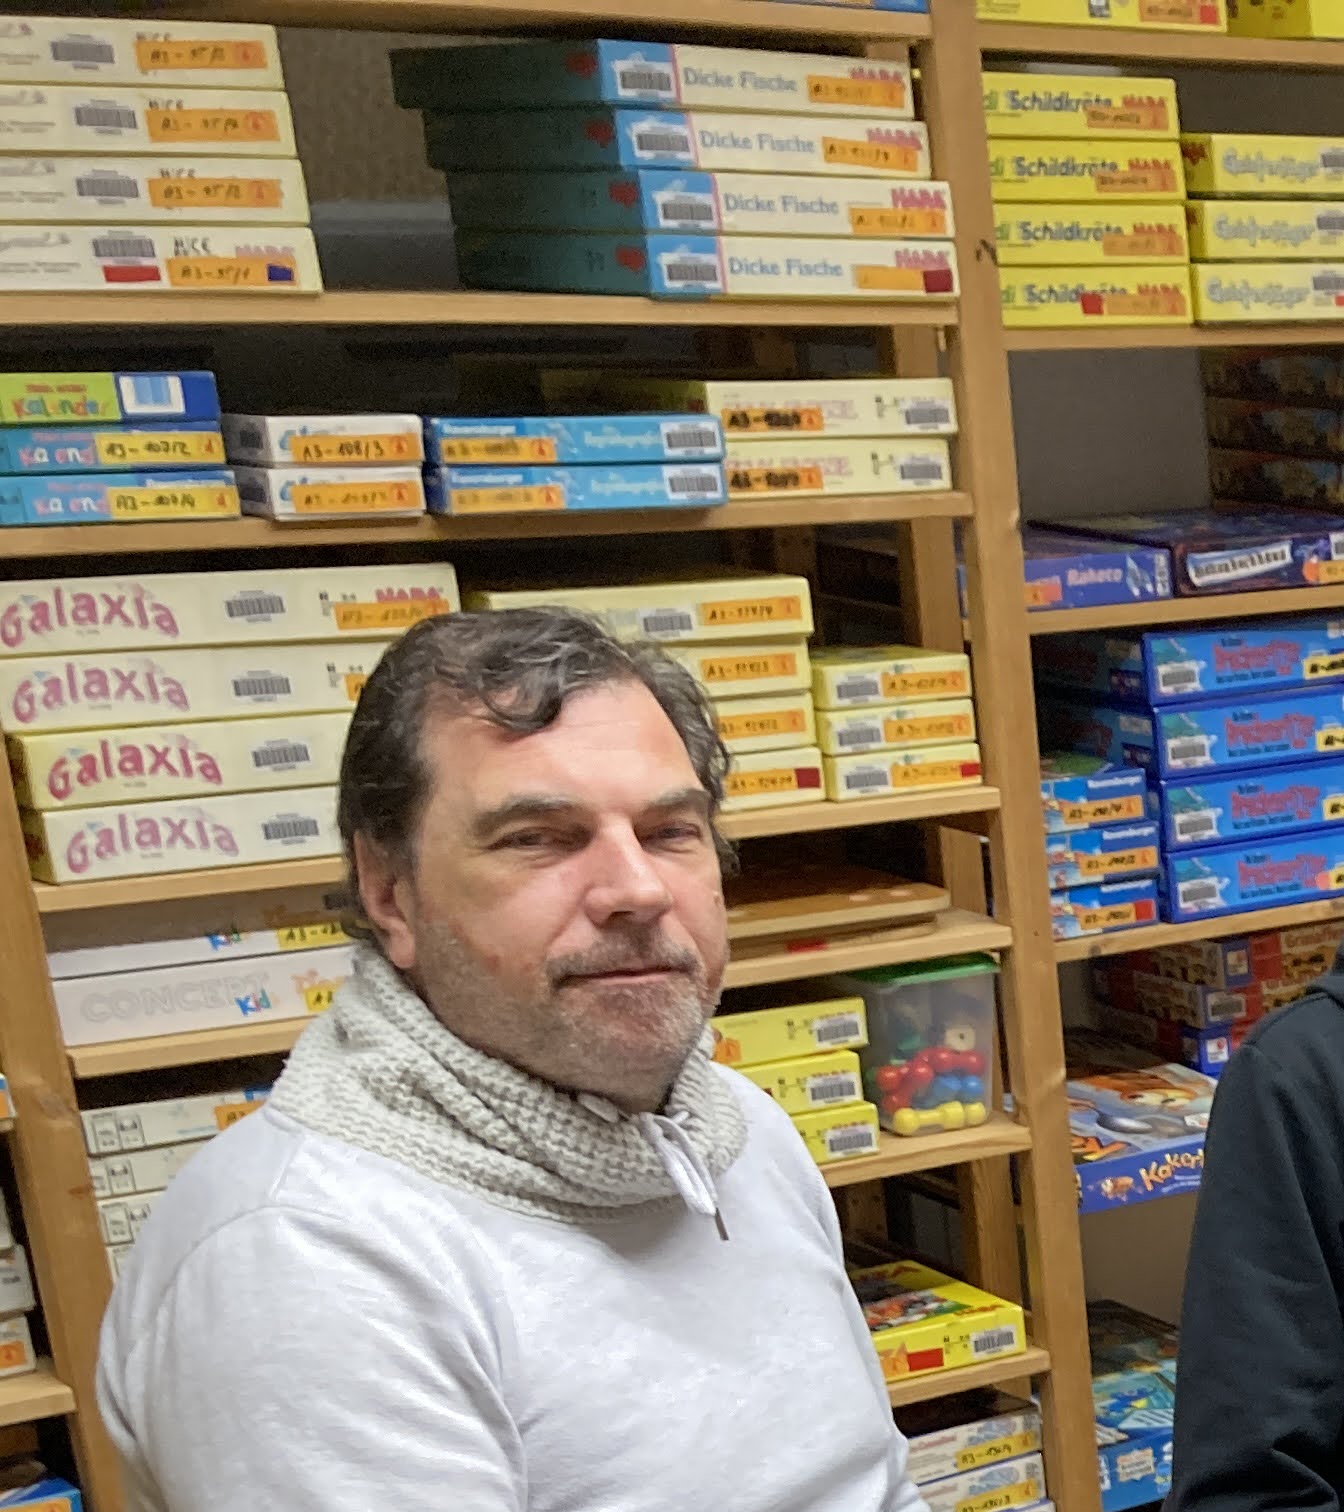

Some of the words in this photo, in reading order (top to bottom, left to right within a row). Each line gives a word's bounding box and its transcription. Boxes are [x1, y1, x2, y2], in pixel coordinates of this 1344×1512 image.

[683, 67, 733, 88] Dicke
[740, 71, 798, 92] Fische
[700, 130, 751, 150] Dicke
[758, 132, 814, 153] Fische
[724, 192, 775, 213] Dicke
[780, 195, 839, 215] Fische
[728, 256, 780, 276] Dicke
[786, 258, 843, 277] Fische
[0, 585, 180, 649] Galaxia
[12, 660, 190, 724] Galaxia
[48, 736, 223, 800] Galaxia
[66, 808, 239, 873] Galaxia
